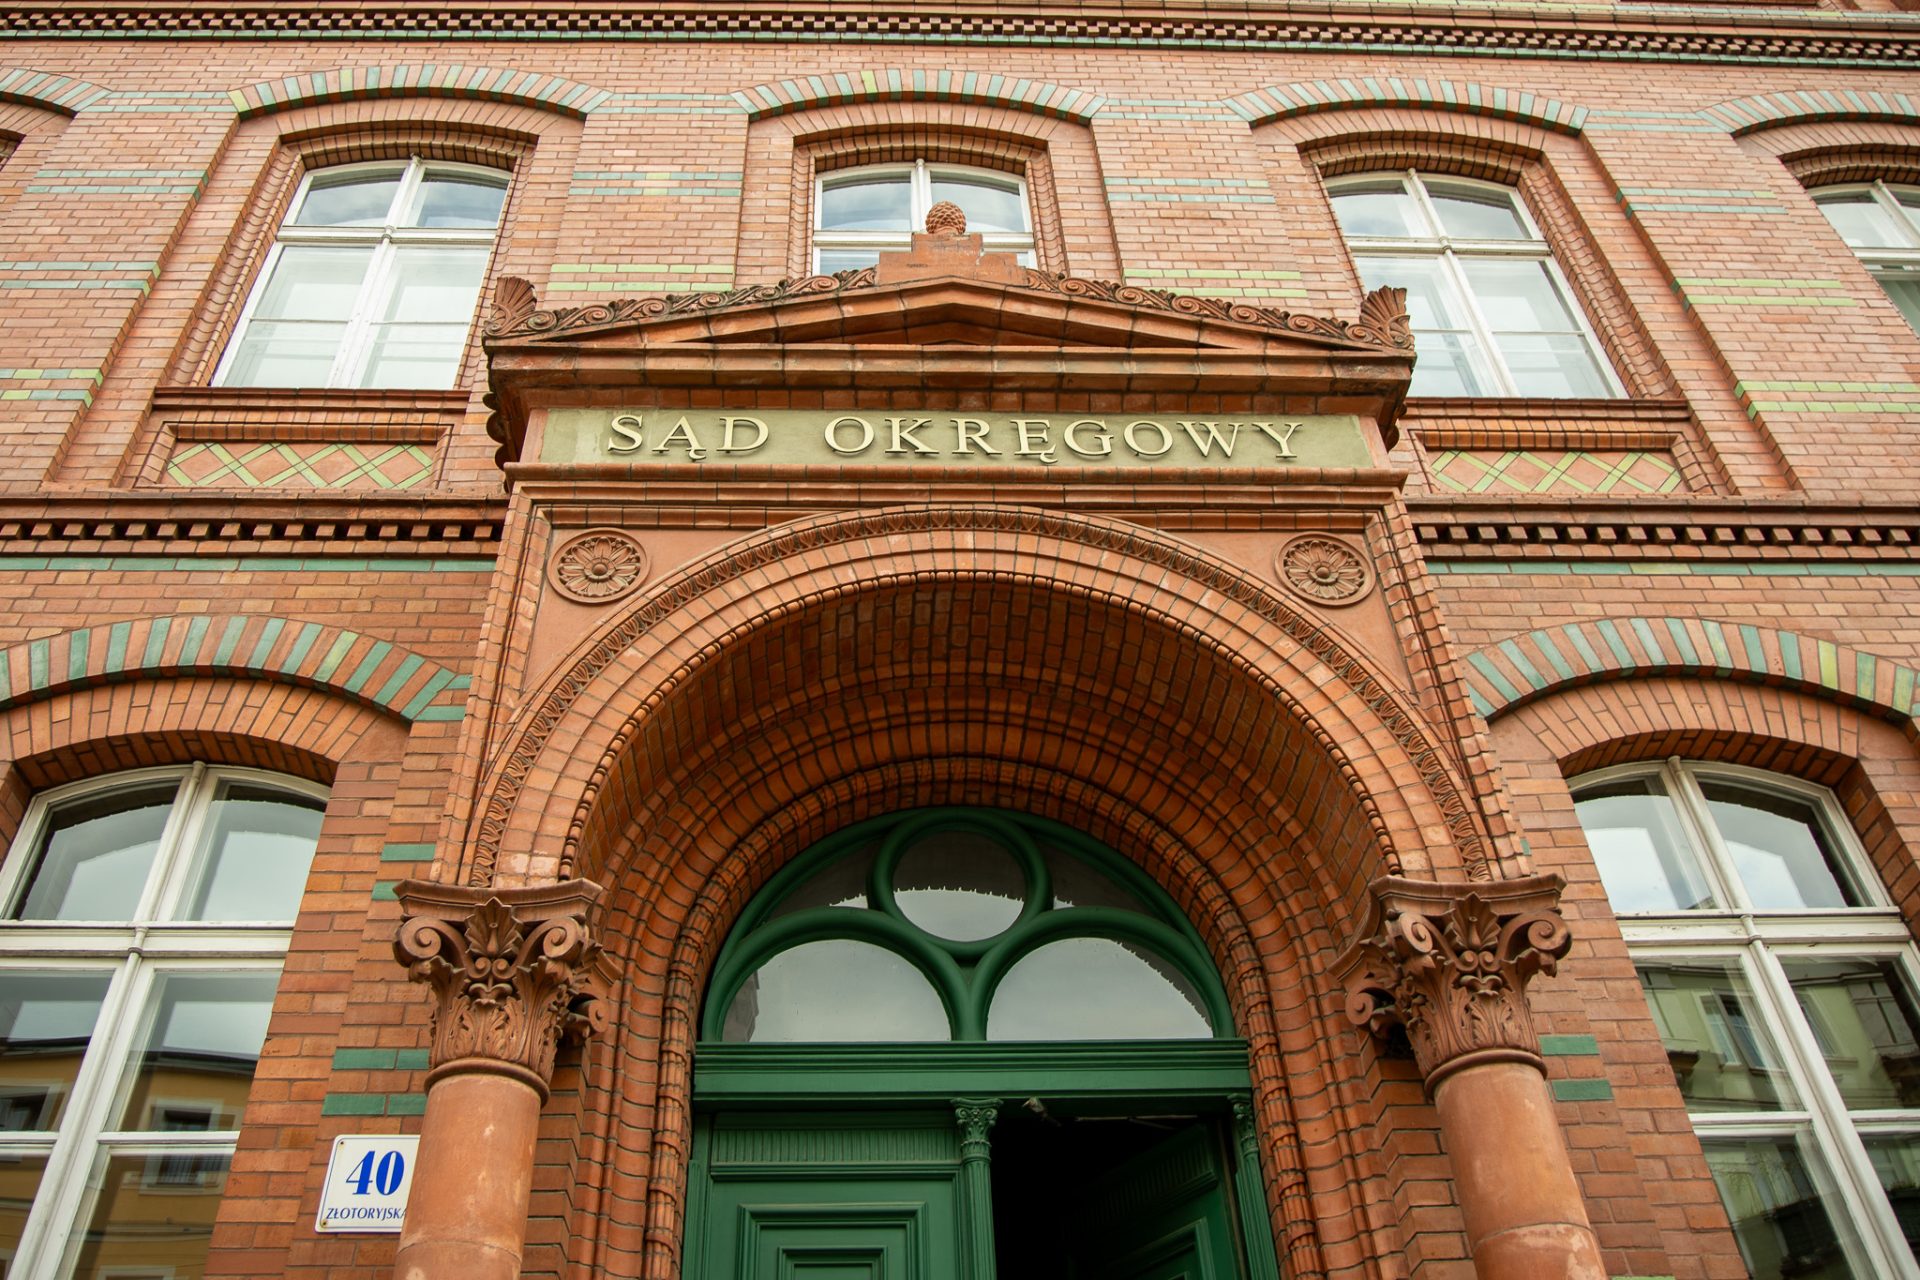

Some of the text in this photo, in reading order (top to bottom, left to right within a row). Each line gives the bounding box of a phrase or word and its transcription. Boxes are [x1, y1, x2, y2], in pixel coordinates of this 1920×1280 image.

[608, 414, 1303, 464] SĄD OKRĘGOWY
[345, 1150, 405, 1196] 40
